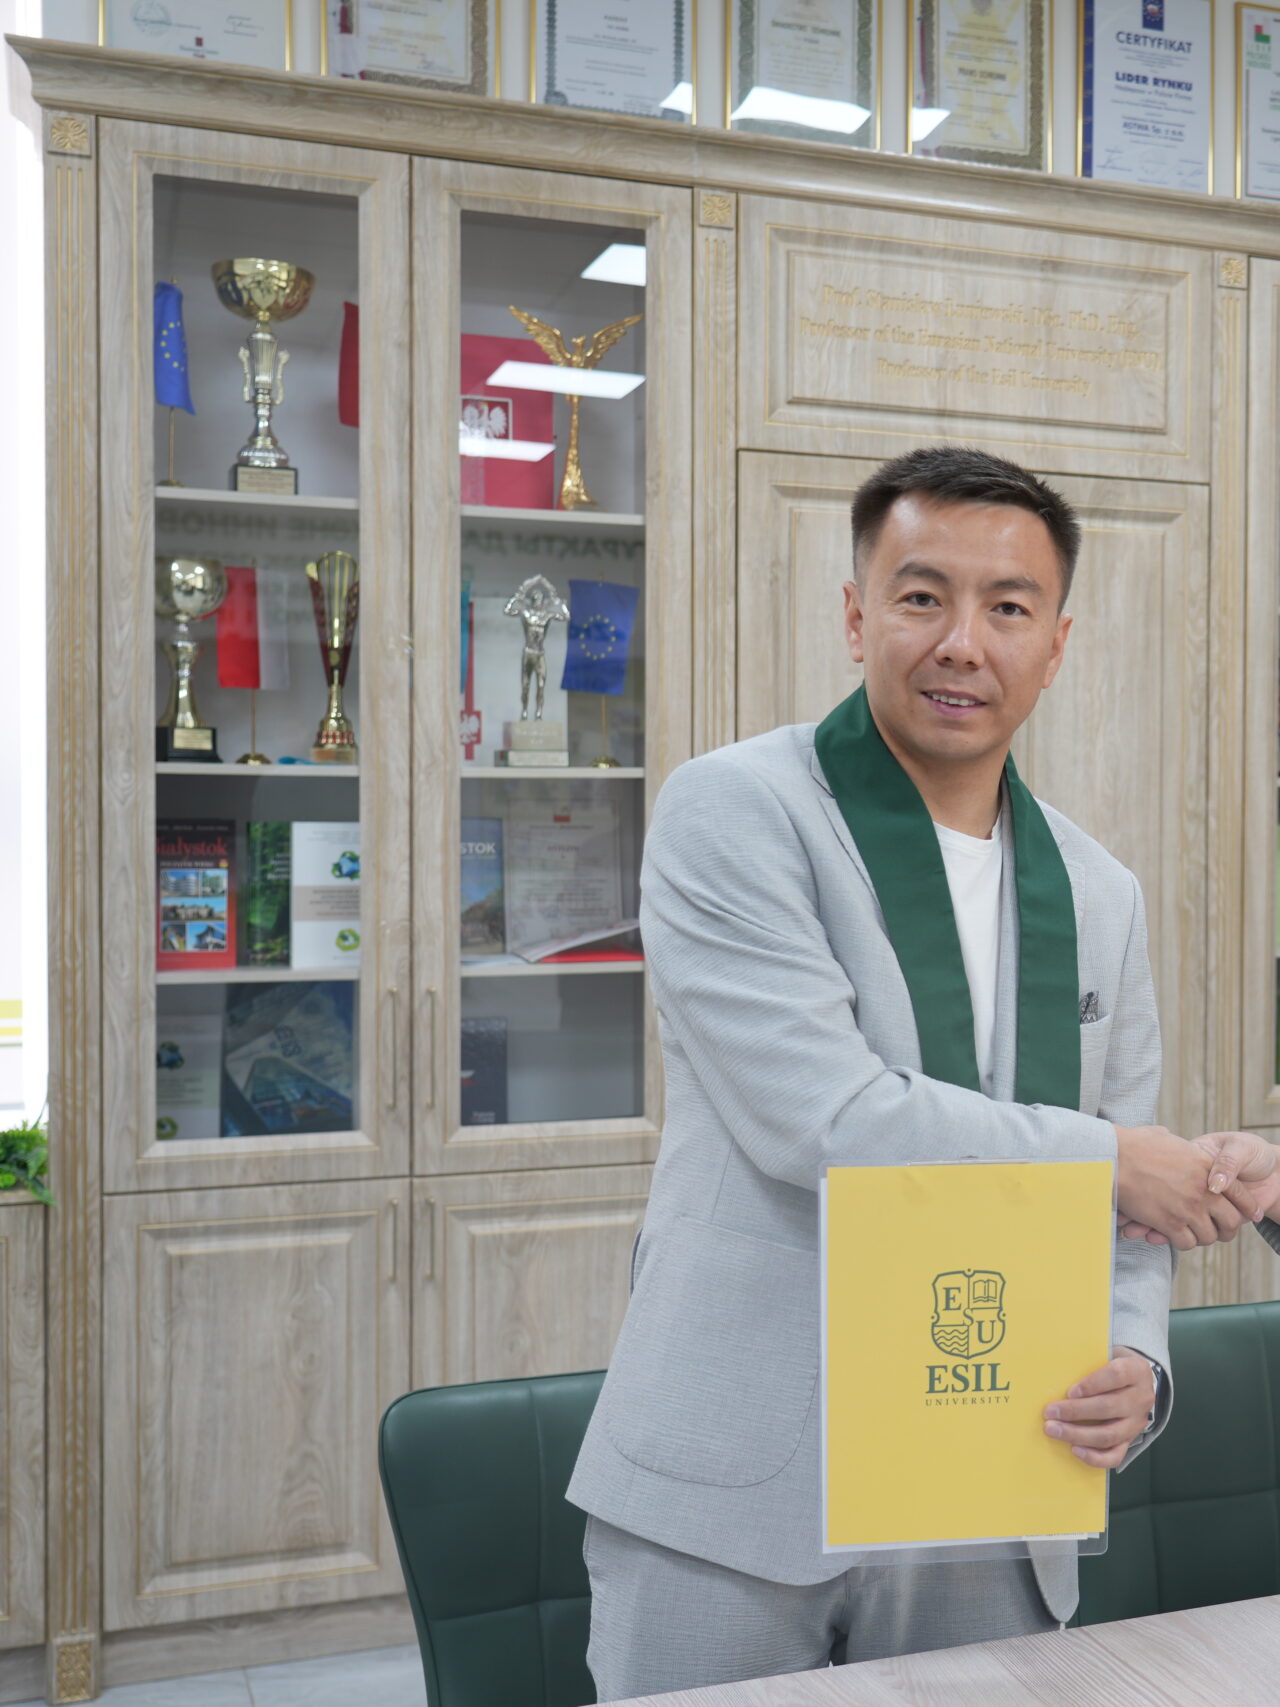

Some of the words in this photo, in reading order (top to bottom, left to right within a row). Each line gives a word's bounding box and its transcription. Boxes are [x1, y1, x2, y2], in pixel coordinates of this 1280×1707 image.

[1116, 31, 1192, 53] CERTYFIKAT
[1116, 72, 1148, 85] LIDER
[1153, 77, 1193, 91] RYNKU
[925, 1363, 1010, 1394] ESIL
[925, 1395, 1011, 1407] UNIVERSITY
